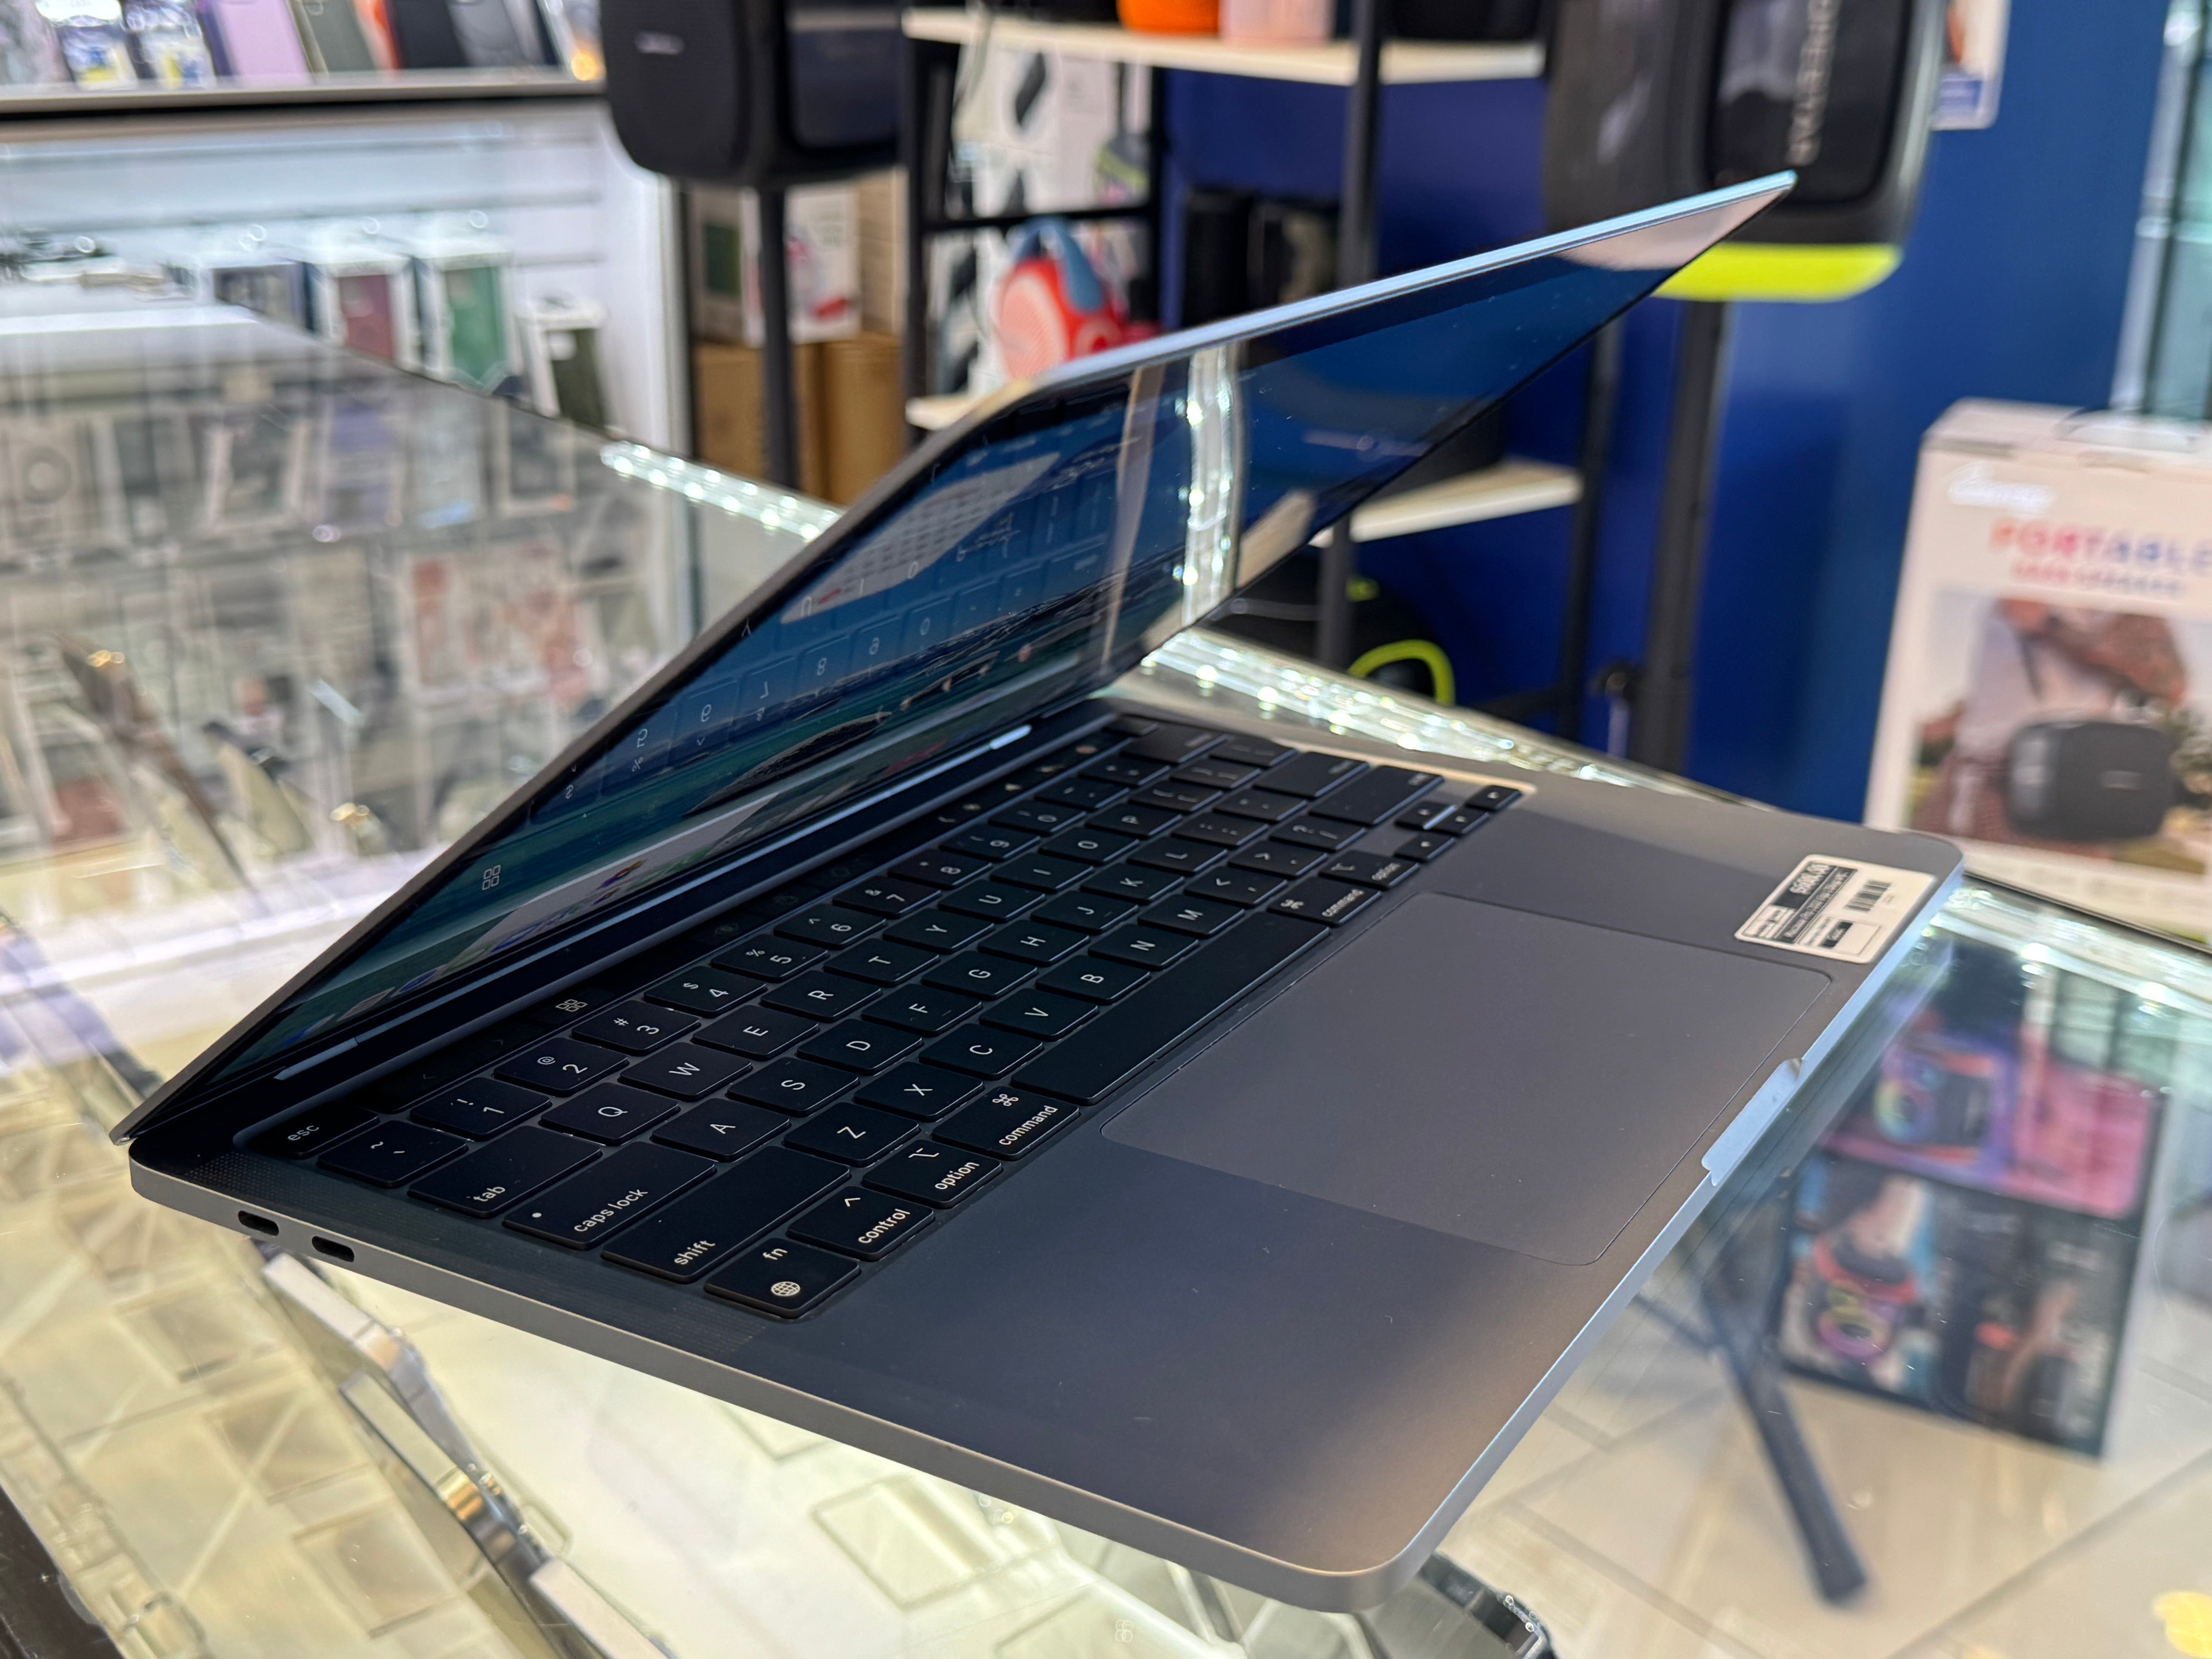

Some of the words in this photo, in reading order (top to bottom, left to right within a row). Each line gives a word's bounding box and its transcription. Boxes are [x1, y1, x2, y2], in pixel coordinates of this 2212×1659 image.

[1078, 841, 1098, 849] O
[940, 866, 961, 874] 8
[1120, 878, 1143, 887] K
[979, 895, 1002, 904] U
[1077, 906, 1094, 915] J
[1177, 909, 1203, 920] M
[831, 924, 852, 932] 6
[926, 924, 947, 933] Y
[1020, 936, 1046, 946] H
[1130, 940, 1155, 951] N
[770, 955, 792, 964] 5
[868, 956, 891, 964] T
[969, 969, 991, 978] G
[1080, 974, 1104, 984] B
[709, 989, 729, 997] 4
[808, 990, 834, 1000] R
[909, 1003, 928, 1013] F
[1024, 1007, 1049, 1017] V
[614, 1018, 629, 1026] #
[637, 1025, 659, 1034] 3
[743, 1026, 768, 1036] E
[846, 1041, 871, 1051] D
[969, 1045, 993, 1055] C
[537, 1056, 556, 1065] @
[562, 1064, 588, 1074] 2
[669, 1062, 700, 1075] W
[781, 1080, 805, 1090] S
[903, 1084, 933, 1096] X
[598, 1106, 628, 1117] Q
[710, 1124, 736, 1134] A
[999, 1106, 1058, 1146] command
[287, 1125, 319, 1141] esc
[837, 1126, 866, 1139] Z
[935, 1162, 980, 1190] option
[473, 1186, 506, 1202] tab
[574, 1209, 614, 1232] caps
[610, 1189, 648, 1209] lock
[858, 1209, 910, 1243] control
[674, 1240, 715, 1265] shift
[763, 1248, 788, 1260] fn
